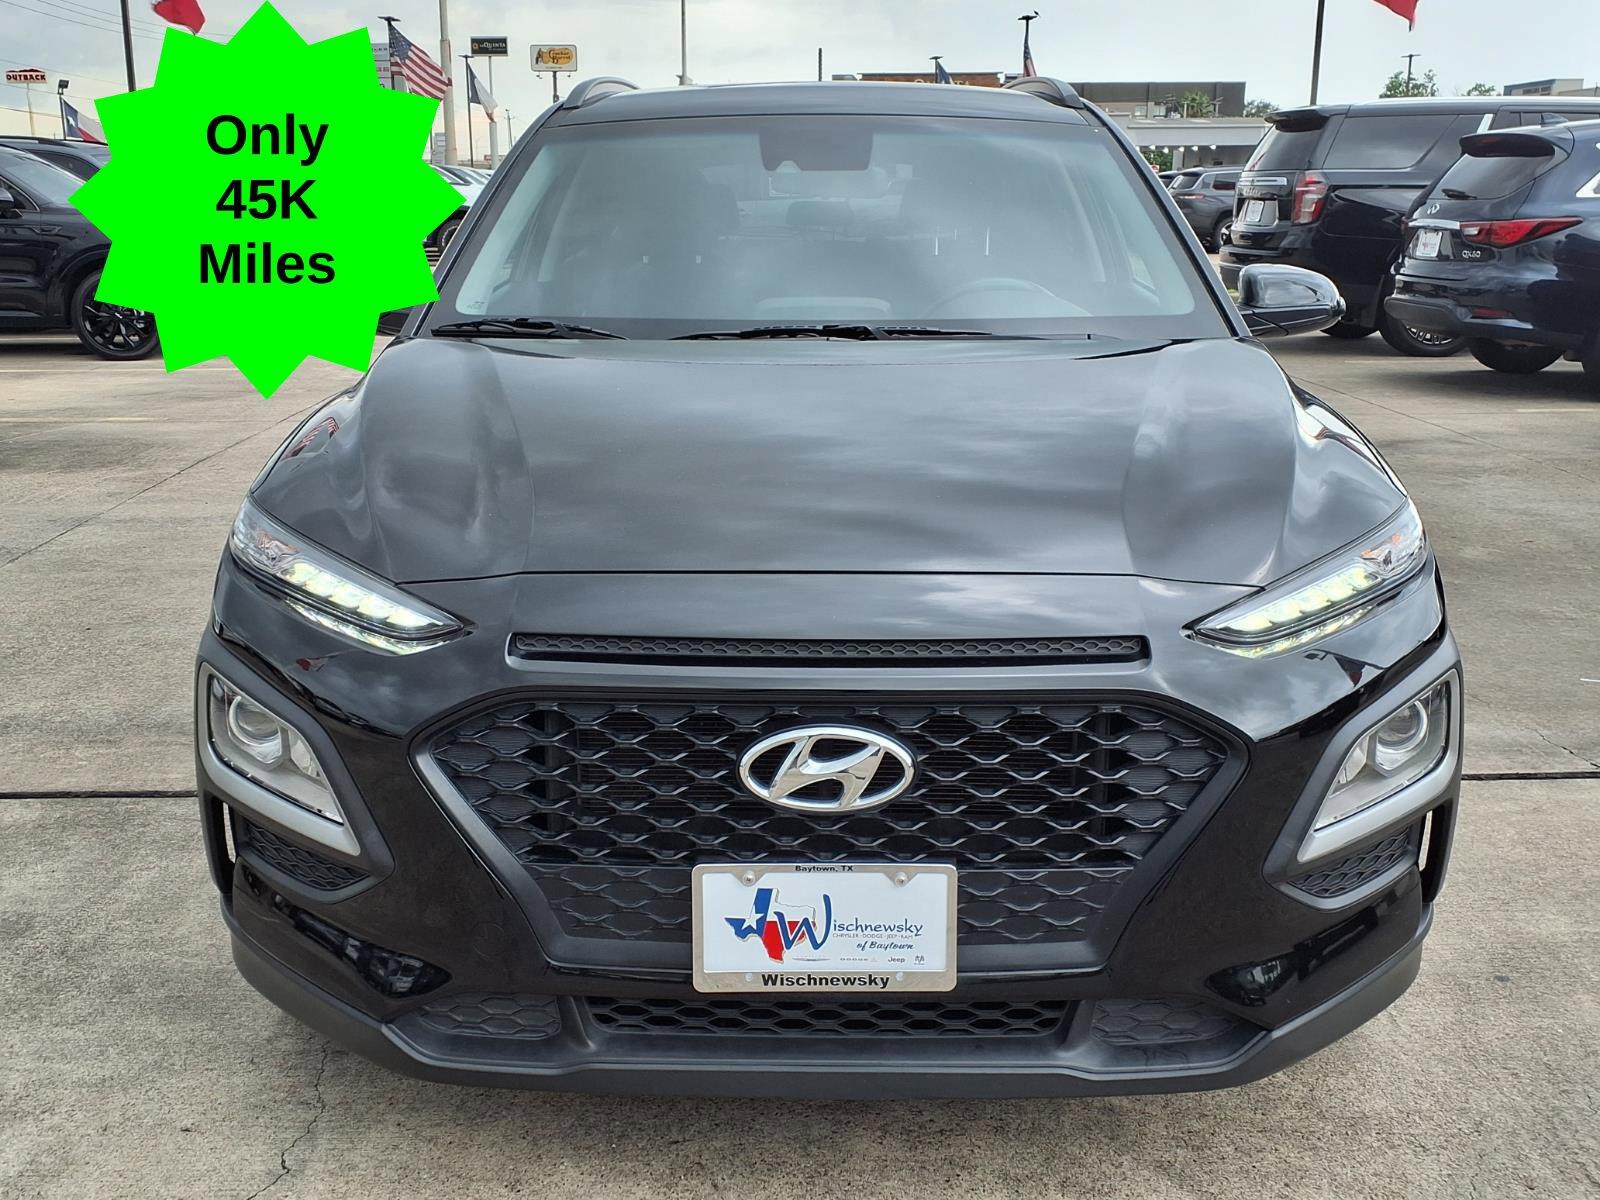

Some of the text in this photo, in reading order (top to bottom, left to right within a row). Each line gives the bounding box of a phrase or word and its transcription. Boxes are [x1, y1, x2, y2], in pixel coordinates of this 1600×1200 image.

[1462, 250, 1481, 258] QX60
[856, 941, 914, 951] of Baytown
[762, 974, 890, 989] Wischnewsky
